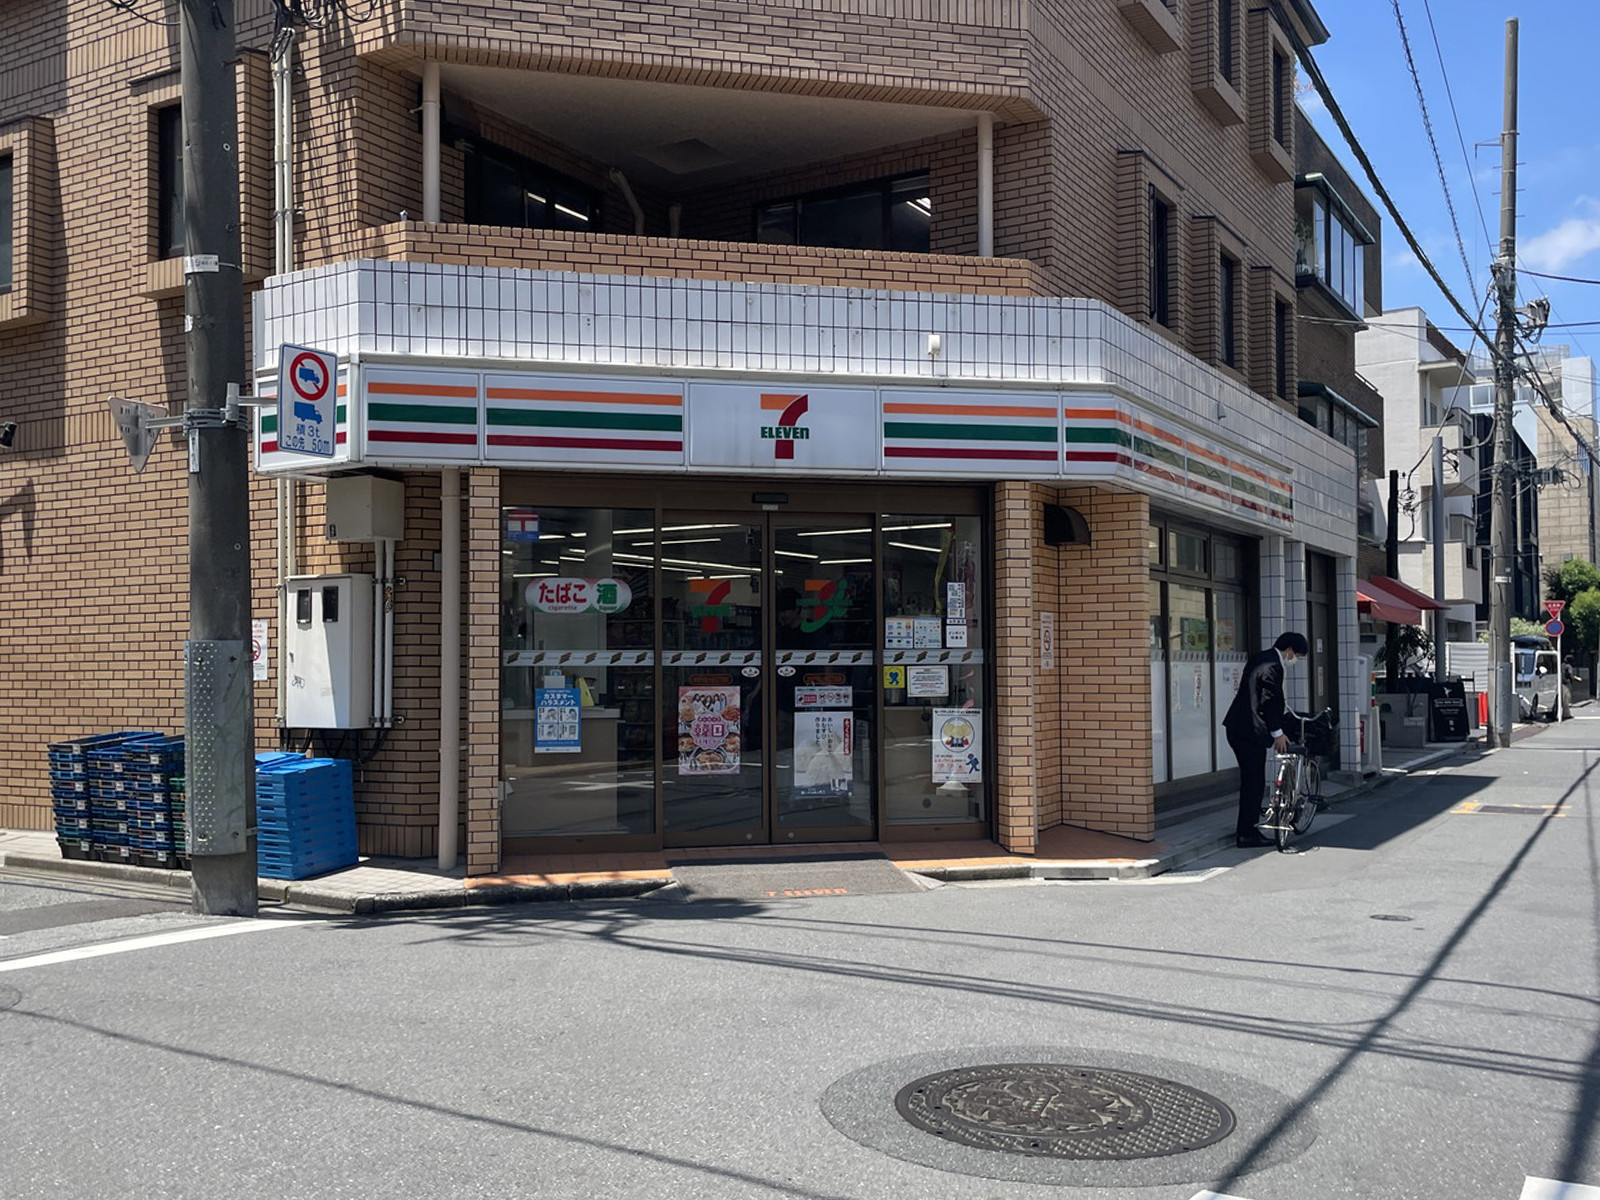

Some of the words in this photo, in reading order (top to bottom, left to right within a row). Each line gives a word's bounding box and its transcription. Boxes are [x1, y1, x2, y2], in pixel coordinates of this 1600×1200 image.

[285, 435, 305, 450] この先
[312, 439, 330, 453] 50m
[539, 583, 587, 604] たばこ
[596, 583, 618, 605] 酒
